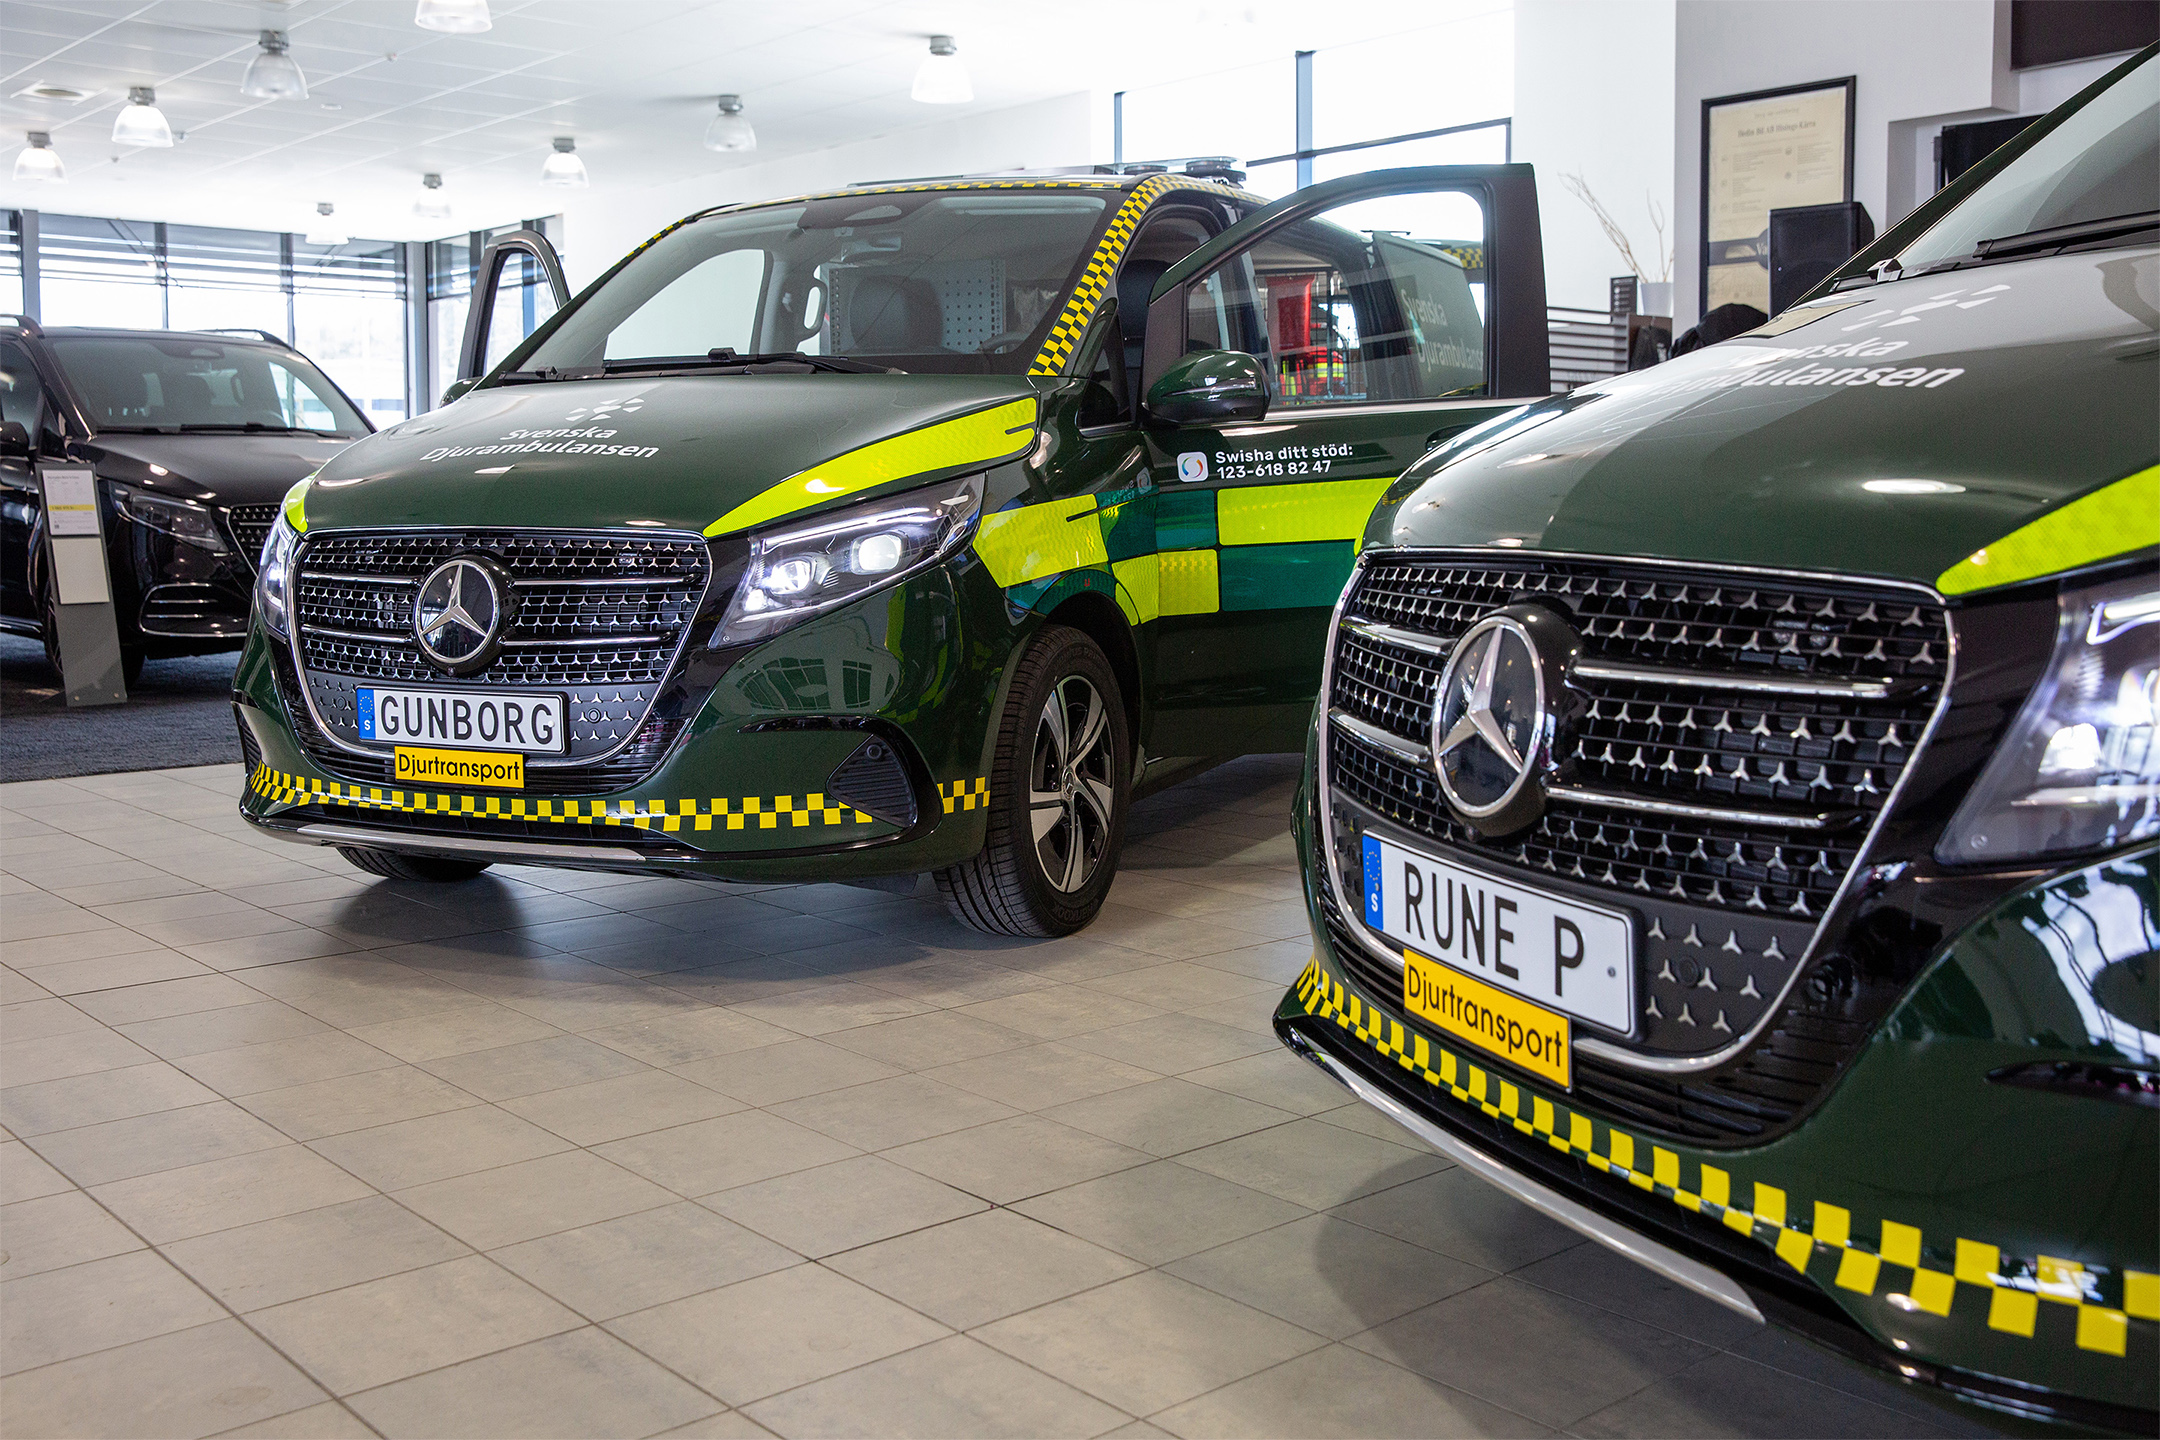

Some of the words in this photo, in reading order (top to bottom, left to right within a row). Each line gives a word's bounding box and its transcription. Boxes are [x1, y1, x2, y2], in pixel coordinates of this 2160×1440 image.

[500, 426, 618, 441] Svenska
[419, 439, 660, 462] Djurambulansen
[1215, 449, 1274, 464] Swisha
[1278, 445, 1308, 460] ditt
[1311, 443, 1353, 458] stöd:
[1216, 462, 1284, 479] 123-618
[1287, 462, 1309, 475] 82
[1312, 459, 1331, 473] 47
[363, 719, 371, 731] S
[380, 695, 553, 745] GUNBORG
[398, 753, 520, 783] Djurtransport
[1370, 892, 1379, 912] S
[1404, 860, 1519, 981] RUNE
[1554, 914, 1584, 997] P
[1408, 964, 1562, 1068] Djurtransport
